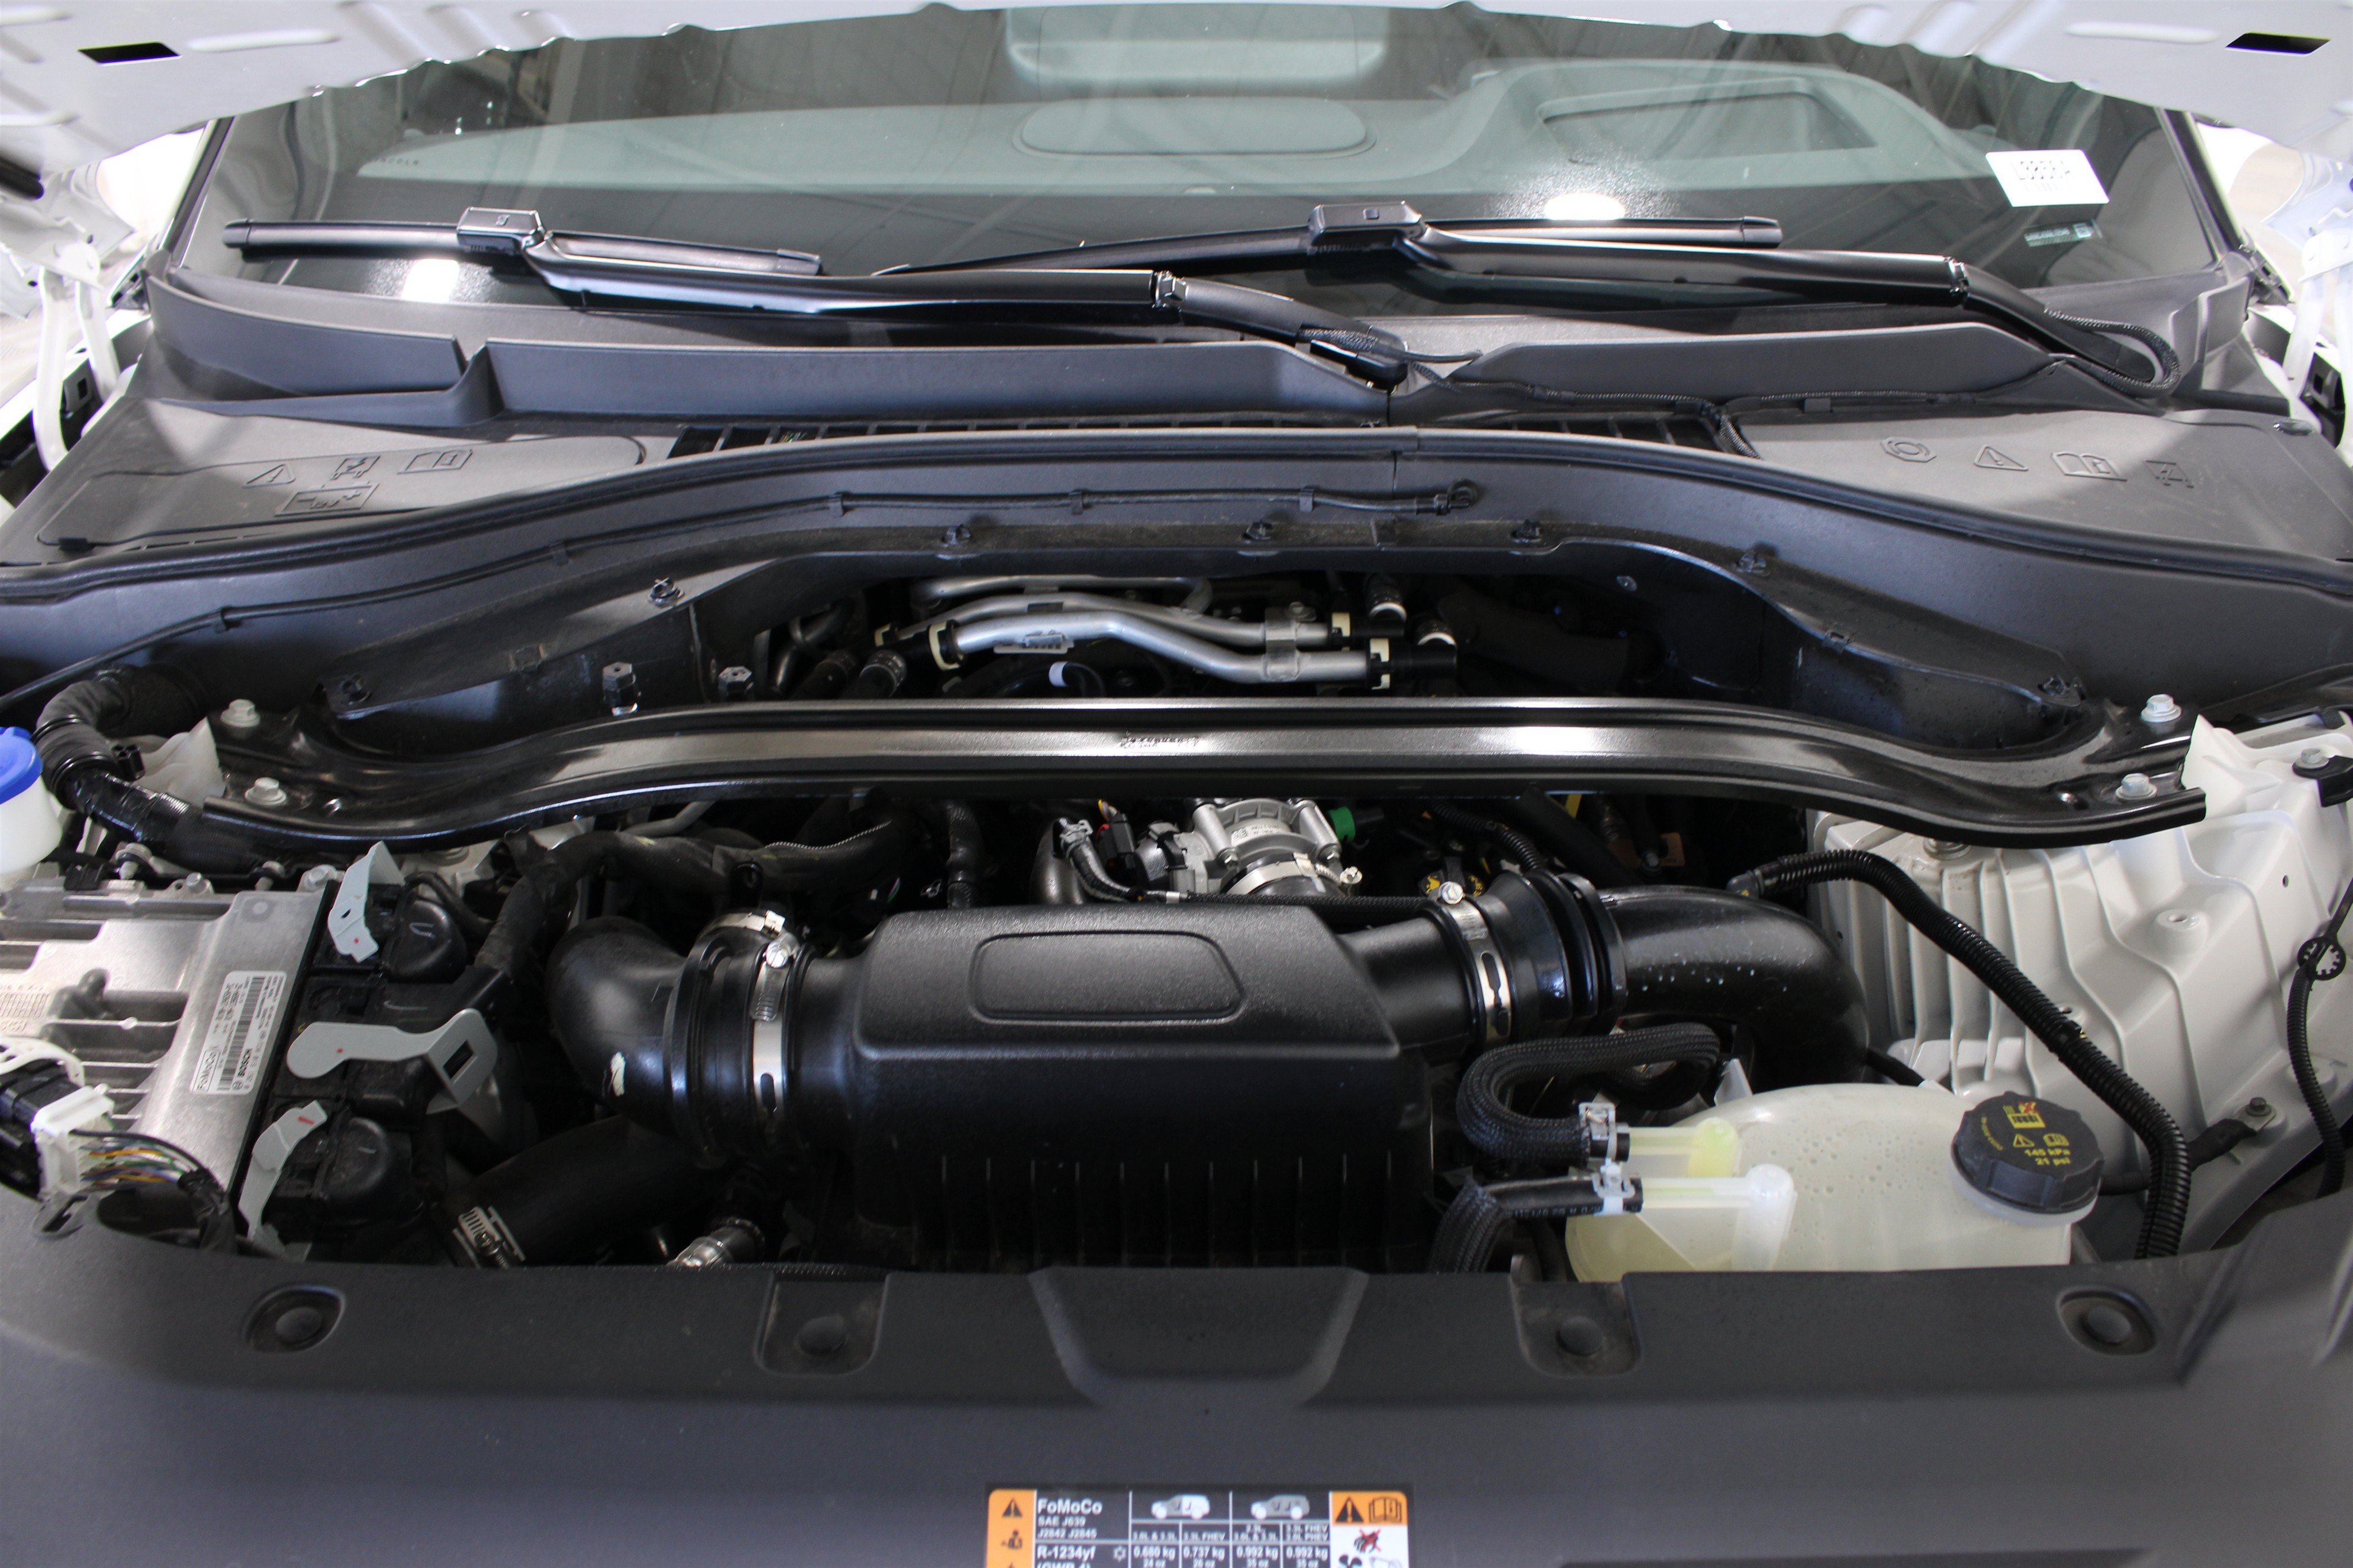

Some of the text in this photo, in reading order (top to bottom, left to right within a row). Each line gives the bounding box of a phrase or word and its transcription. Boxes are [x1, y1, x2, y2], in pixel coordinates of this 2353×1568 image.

[237, 1048, 253, 1077] BOSCH
[197, 1052, 217, 1090] FoMoCo
[1037, 1497, 1103, 1515] FoMoCo
[1037, 1516, 1060, 1527] SAE
[1036, 1545, 1097, 1562] R-1234yf
[1162, 1545, 1176, 1561] kg
[1183, 1545, 1225, 1561] 0.737 kg
[1265, 1545, 1279, 1561] kg
[1314, 1545, 1328, 1561] kg
